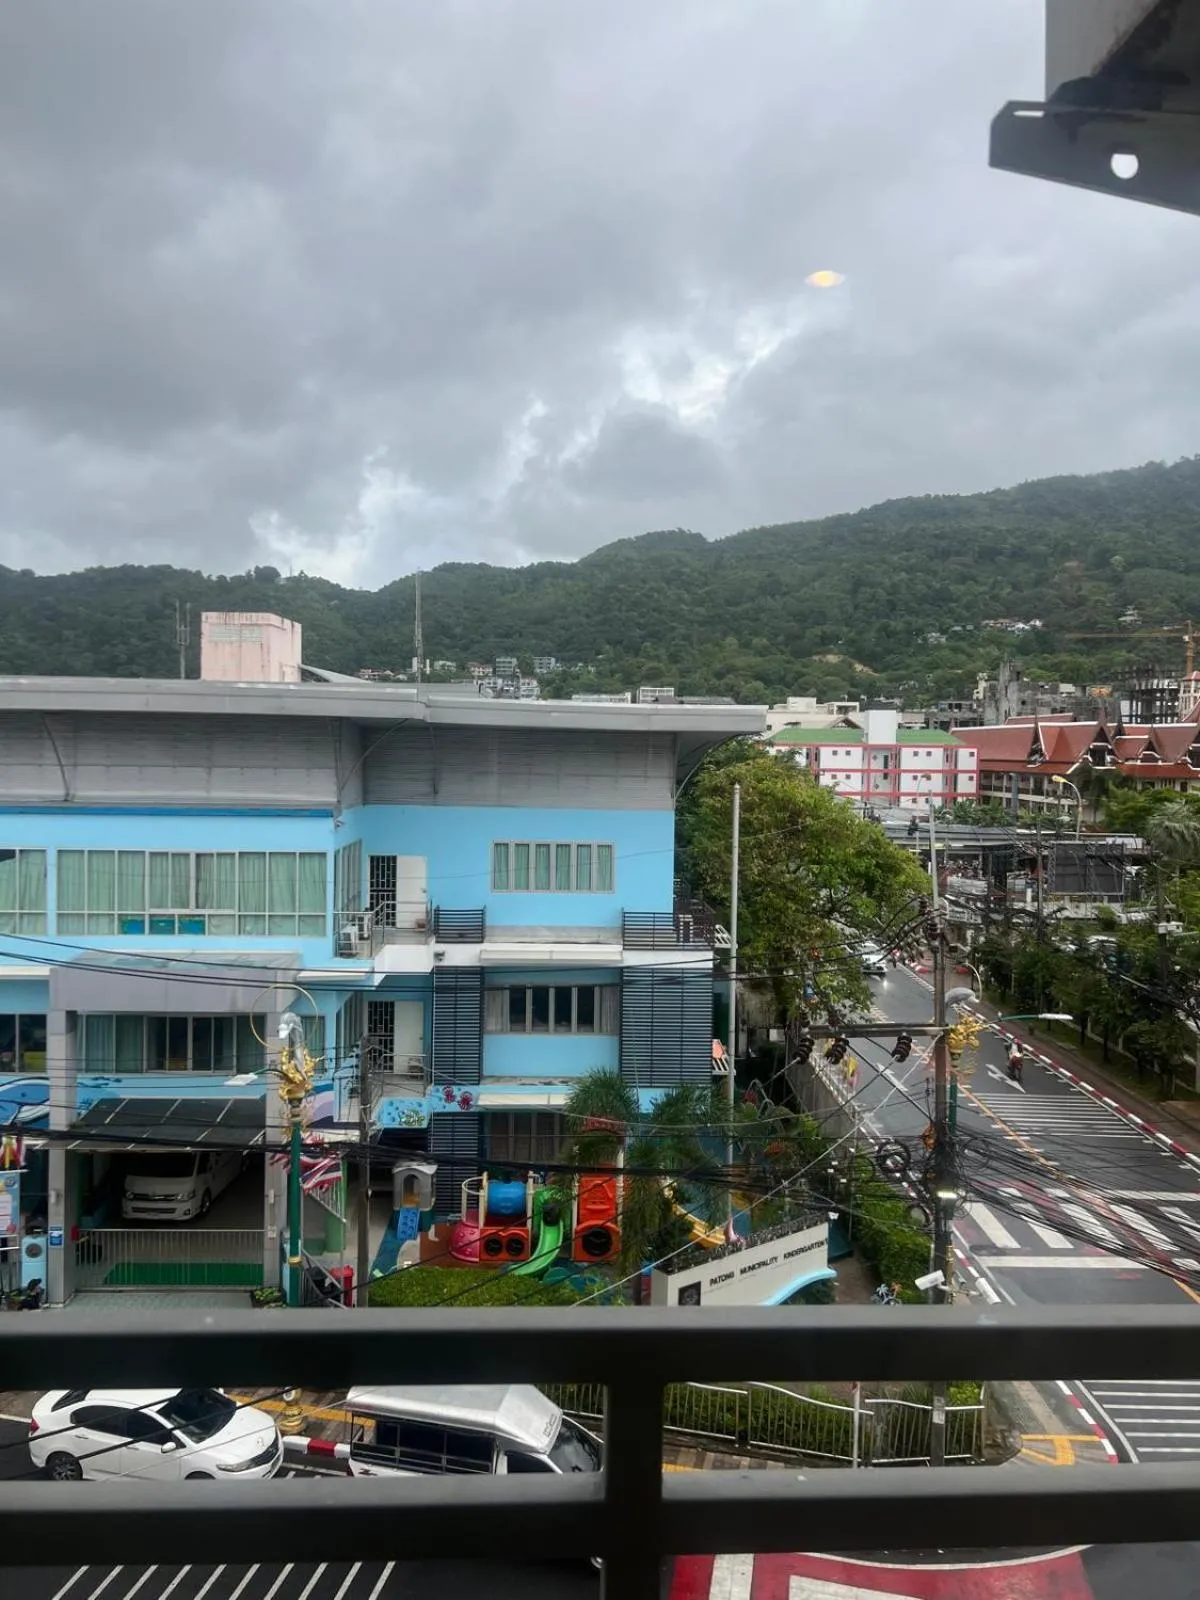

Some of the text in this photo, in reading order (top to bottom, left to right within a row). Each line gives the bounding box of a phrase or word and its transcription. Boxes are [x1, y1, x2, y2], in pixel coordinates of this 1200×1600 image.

[709, 1240, 825, 1286] PATONG MUNICIPALITY KINDERGARTEN
